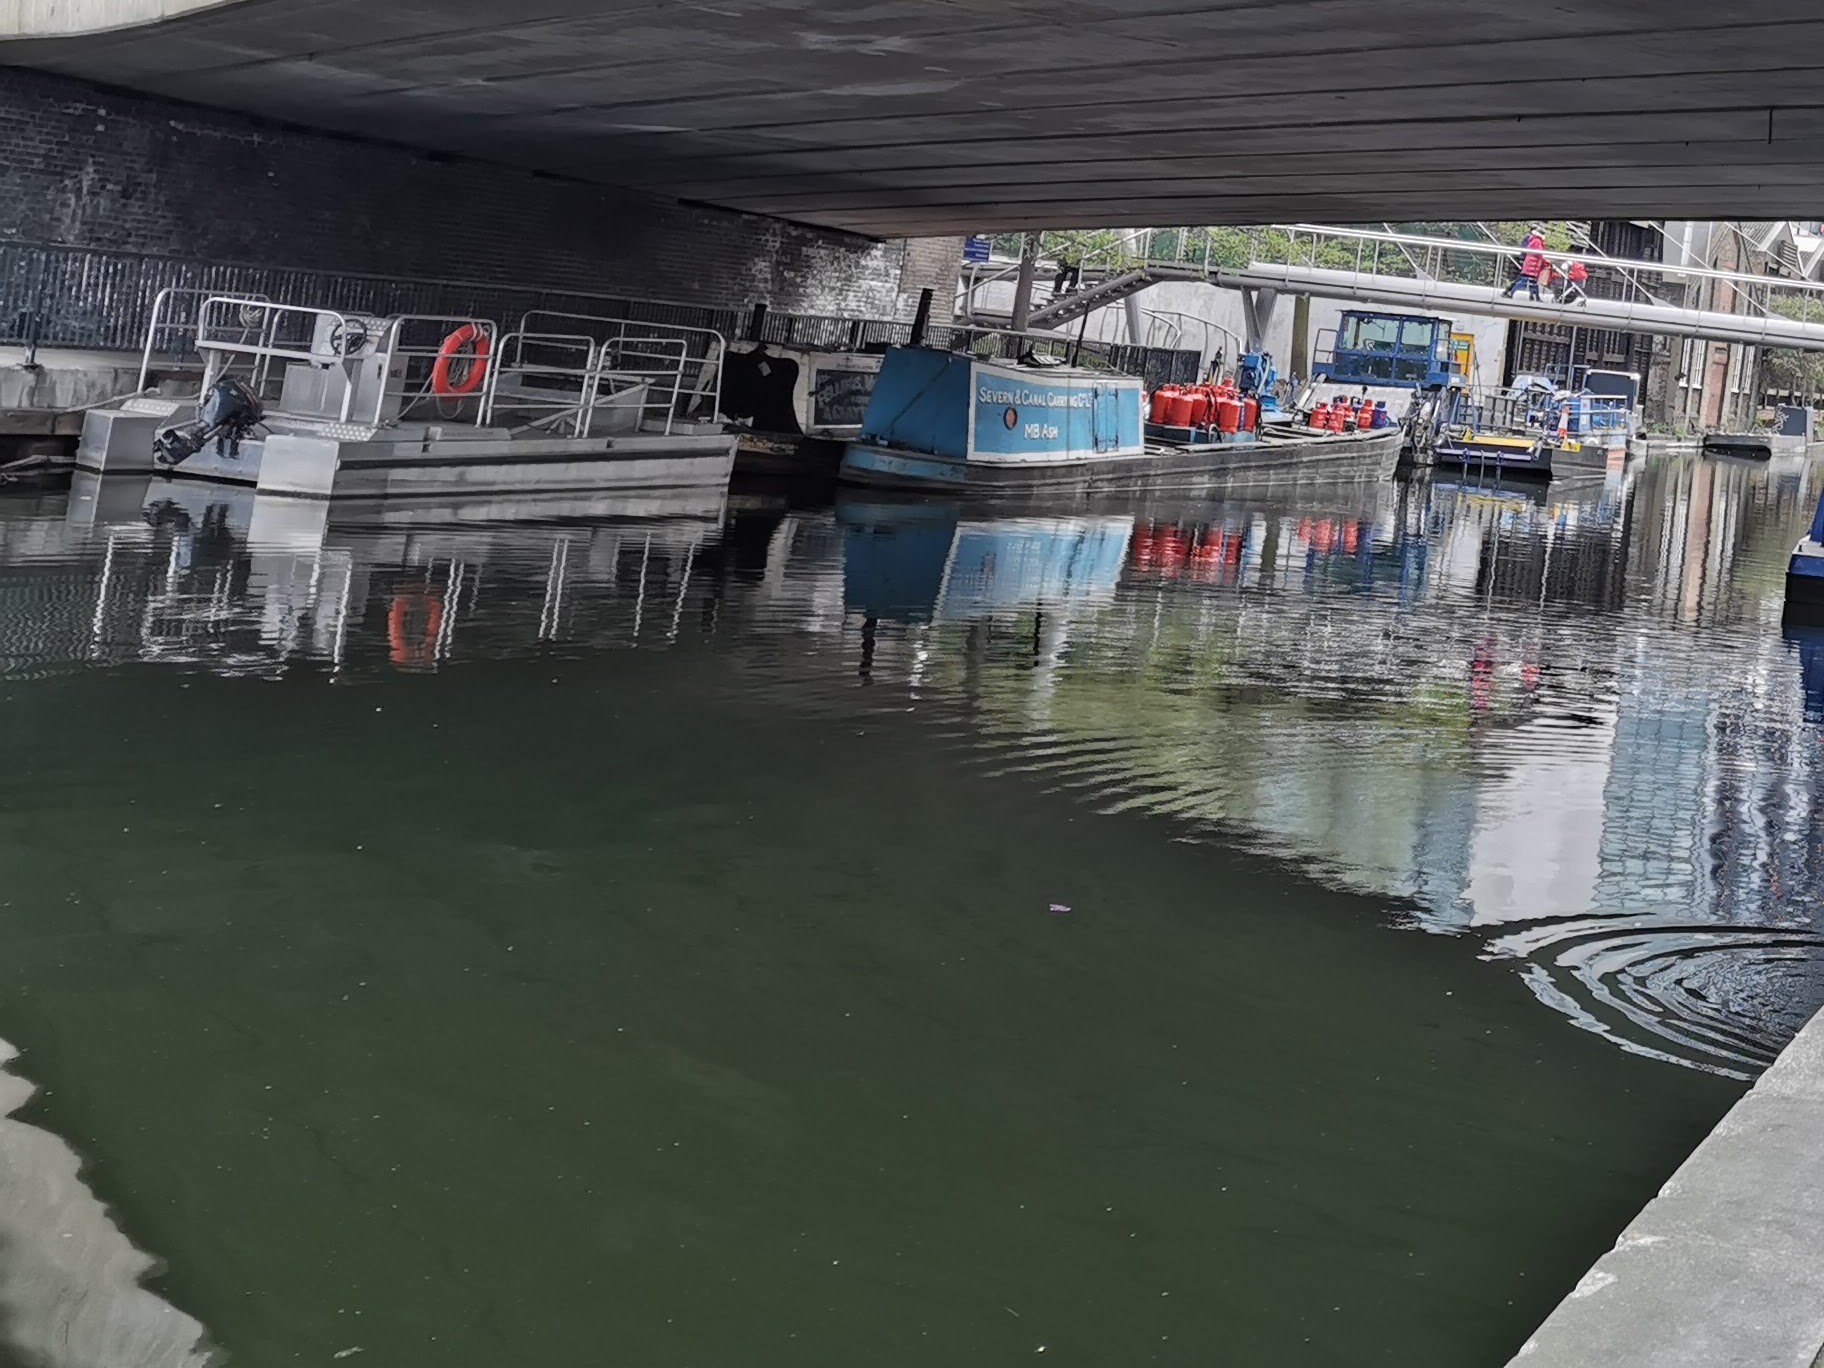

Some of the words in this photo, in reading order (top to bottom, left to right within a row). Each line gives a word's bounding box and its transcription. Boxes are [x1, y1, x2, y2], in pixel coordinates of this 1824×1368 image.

[1015, 389, 1021, 405] &
[1024, 423, 1040, 439] MB
[1041, 423, 1059, 439] ASH
